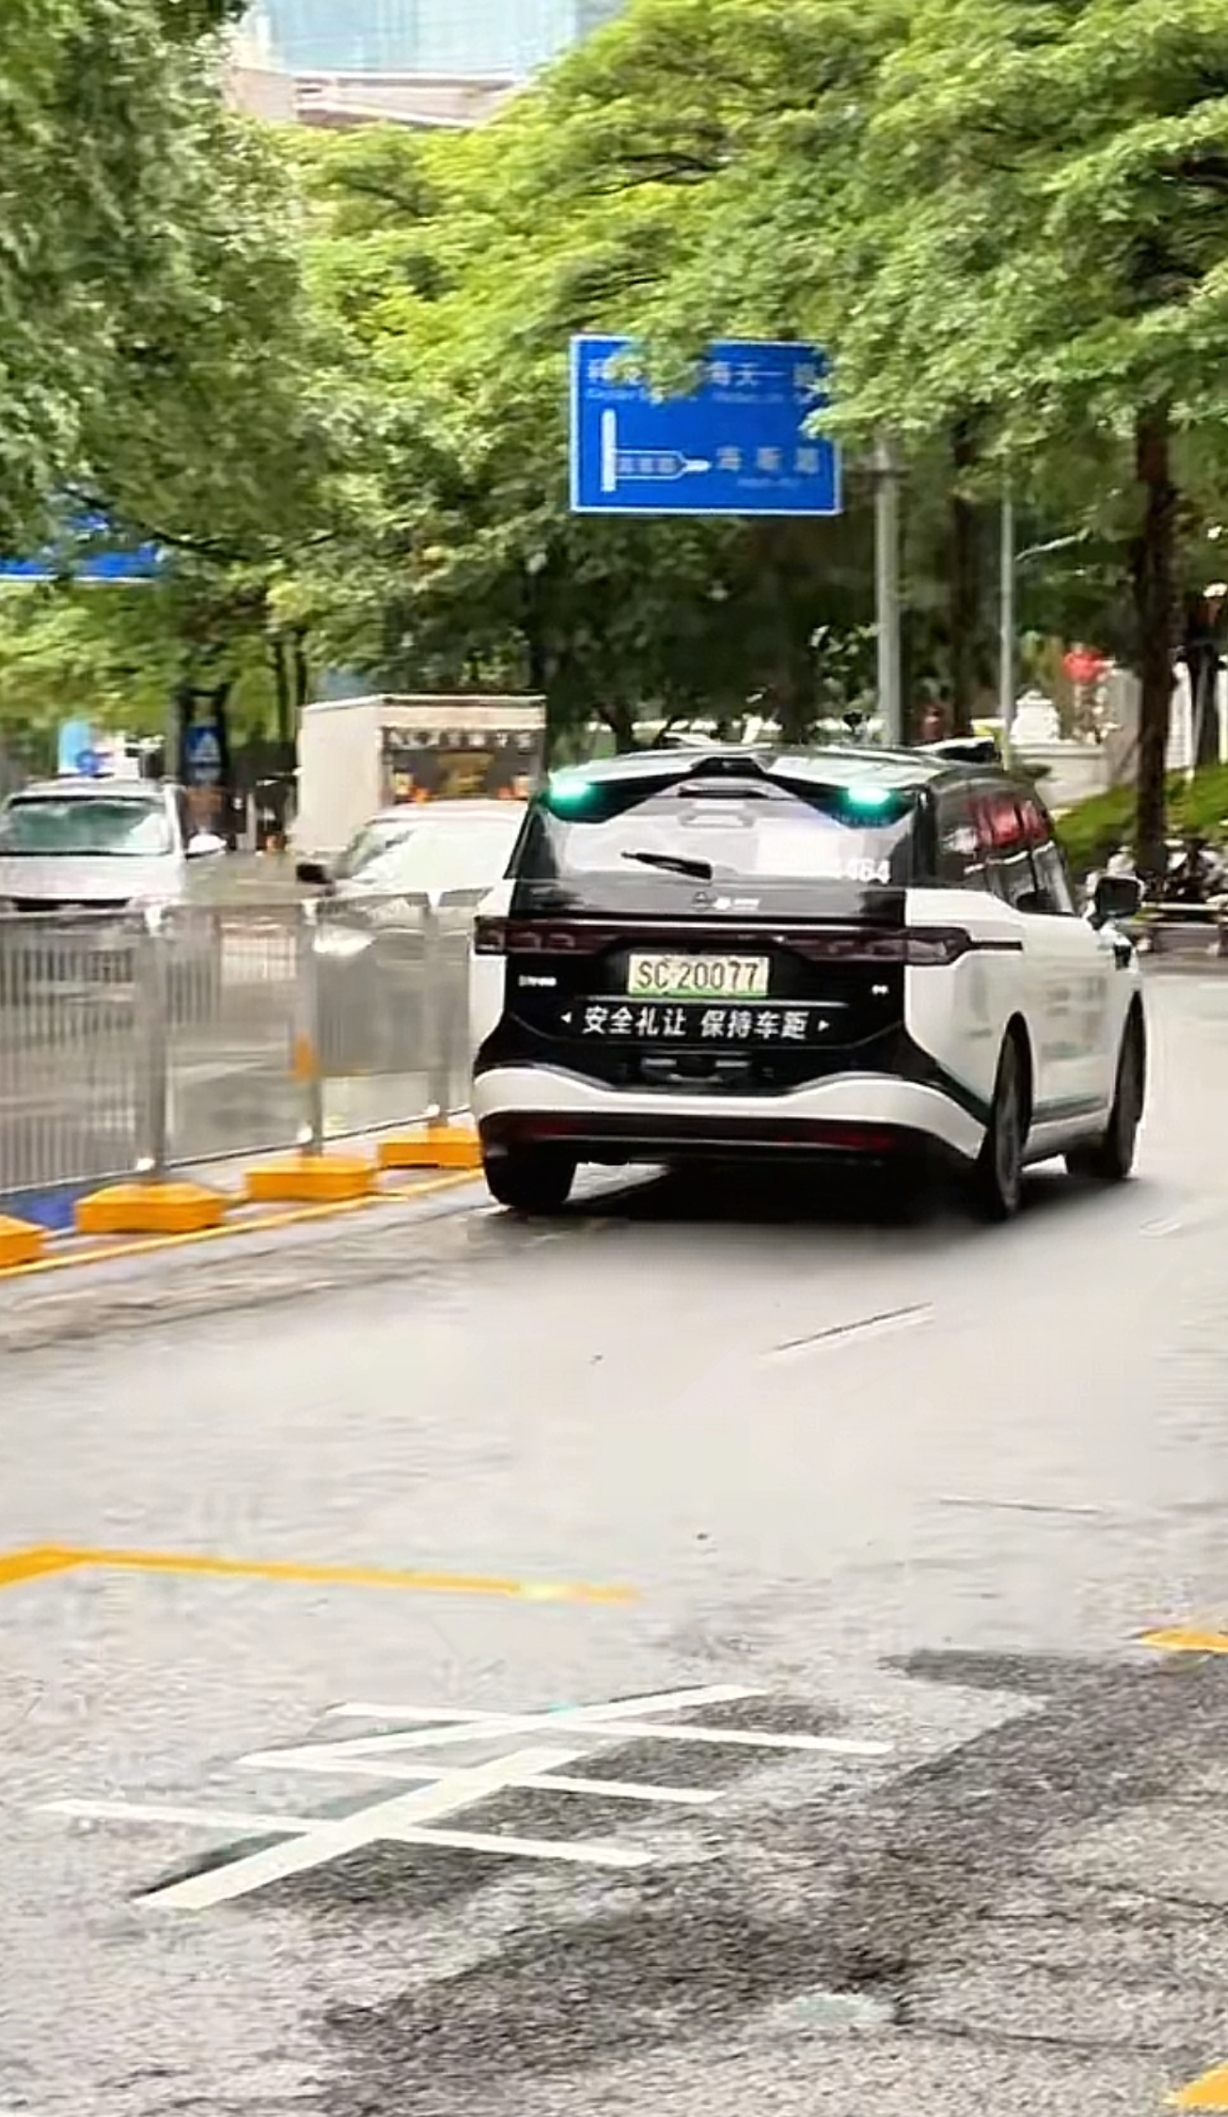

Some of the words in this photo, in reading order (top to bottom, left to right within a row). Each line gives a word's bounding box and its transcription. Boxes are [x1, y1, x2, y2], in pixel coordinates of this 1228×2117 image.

[582, 1005, 687, 1036] 安全礼让
[700, 1009, 809, 1039] 保持车距
